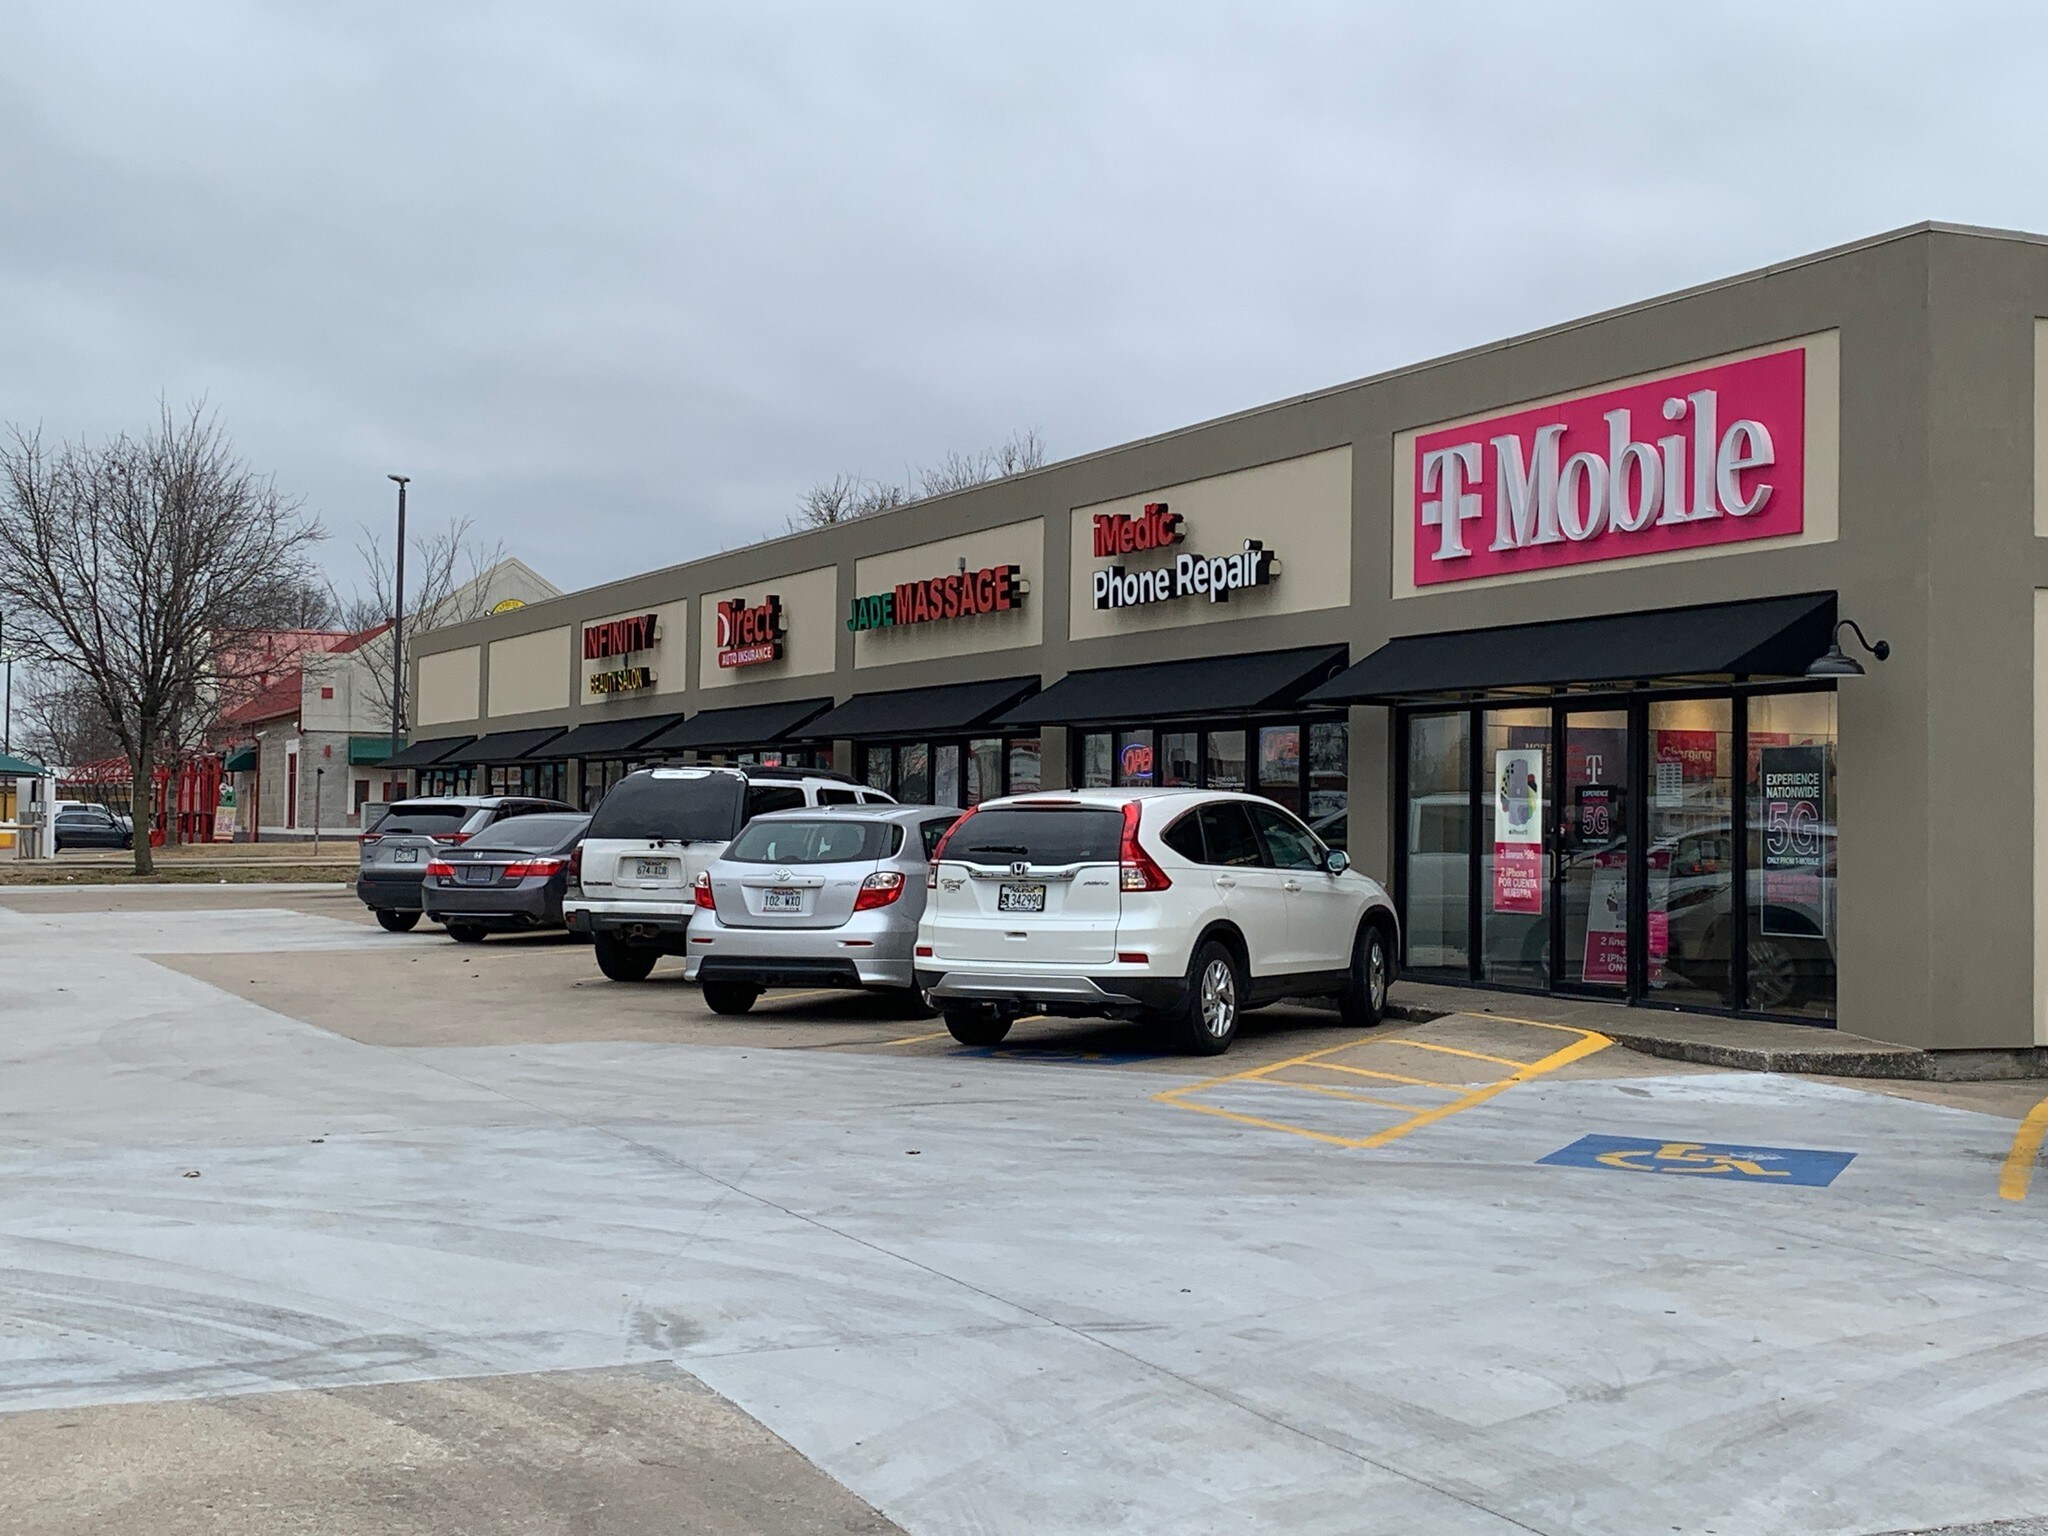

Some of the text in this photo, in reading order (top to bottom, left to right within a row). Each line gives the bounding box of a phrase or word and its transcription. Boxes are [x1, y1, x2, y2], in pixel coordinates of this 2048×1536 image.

[1093, 503, 1176, 557] iMedic
[1093, 538, 1262, 610] Phone Repair
[846, 565, 1011, 632] JADE MASSAGE
[717, 596, 774, 648] Direct
[722, 646, 772, 666] AUTO INSURANCE
[590, 667, 643, 695] BEAUTY SALON
[1766, 773, 1819, 785] EXPERIENCE
[1766, 786, 1819, 798] NATIONWIDE
[1583, 806, 1609, 834] 5G
[1767, 801, 1819, 855] 5G
[1500, 849, 1505, 859] 2
[1766, 856, 1779, 864] ONLY
[1795, 857, 1819, 865] T-MOBILE
[636, 866, 650, 875] 674
[1500, 867, 1534, 878] 2 iPhone 11
[1498, 878, 1537, 889] POR CUENTA
[1503, 888, 1532, 899] NUESTRA
[1010, 894, 1042, 906] 342990
[1600, 936, 1607, 946] 2
[1599, 953, 1606, 962] 2
